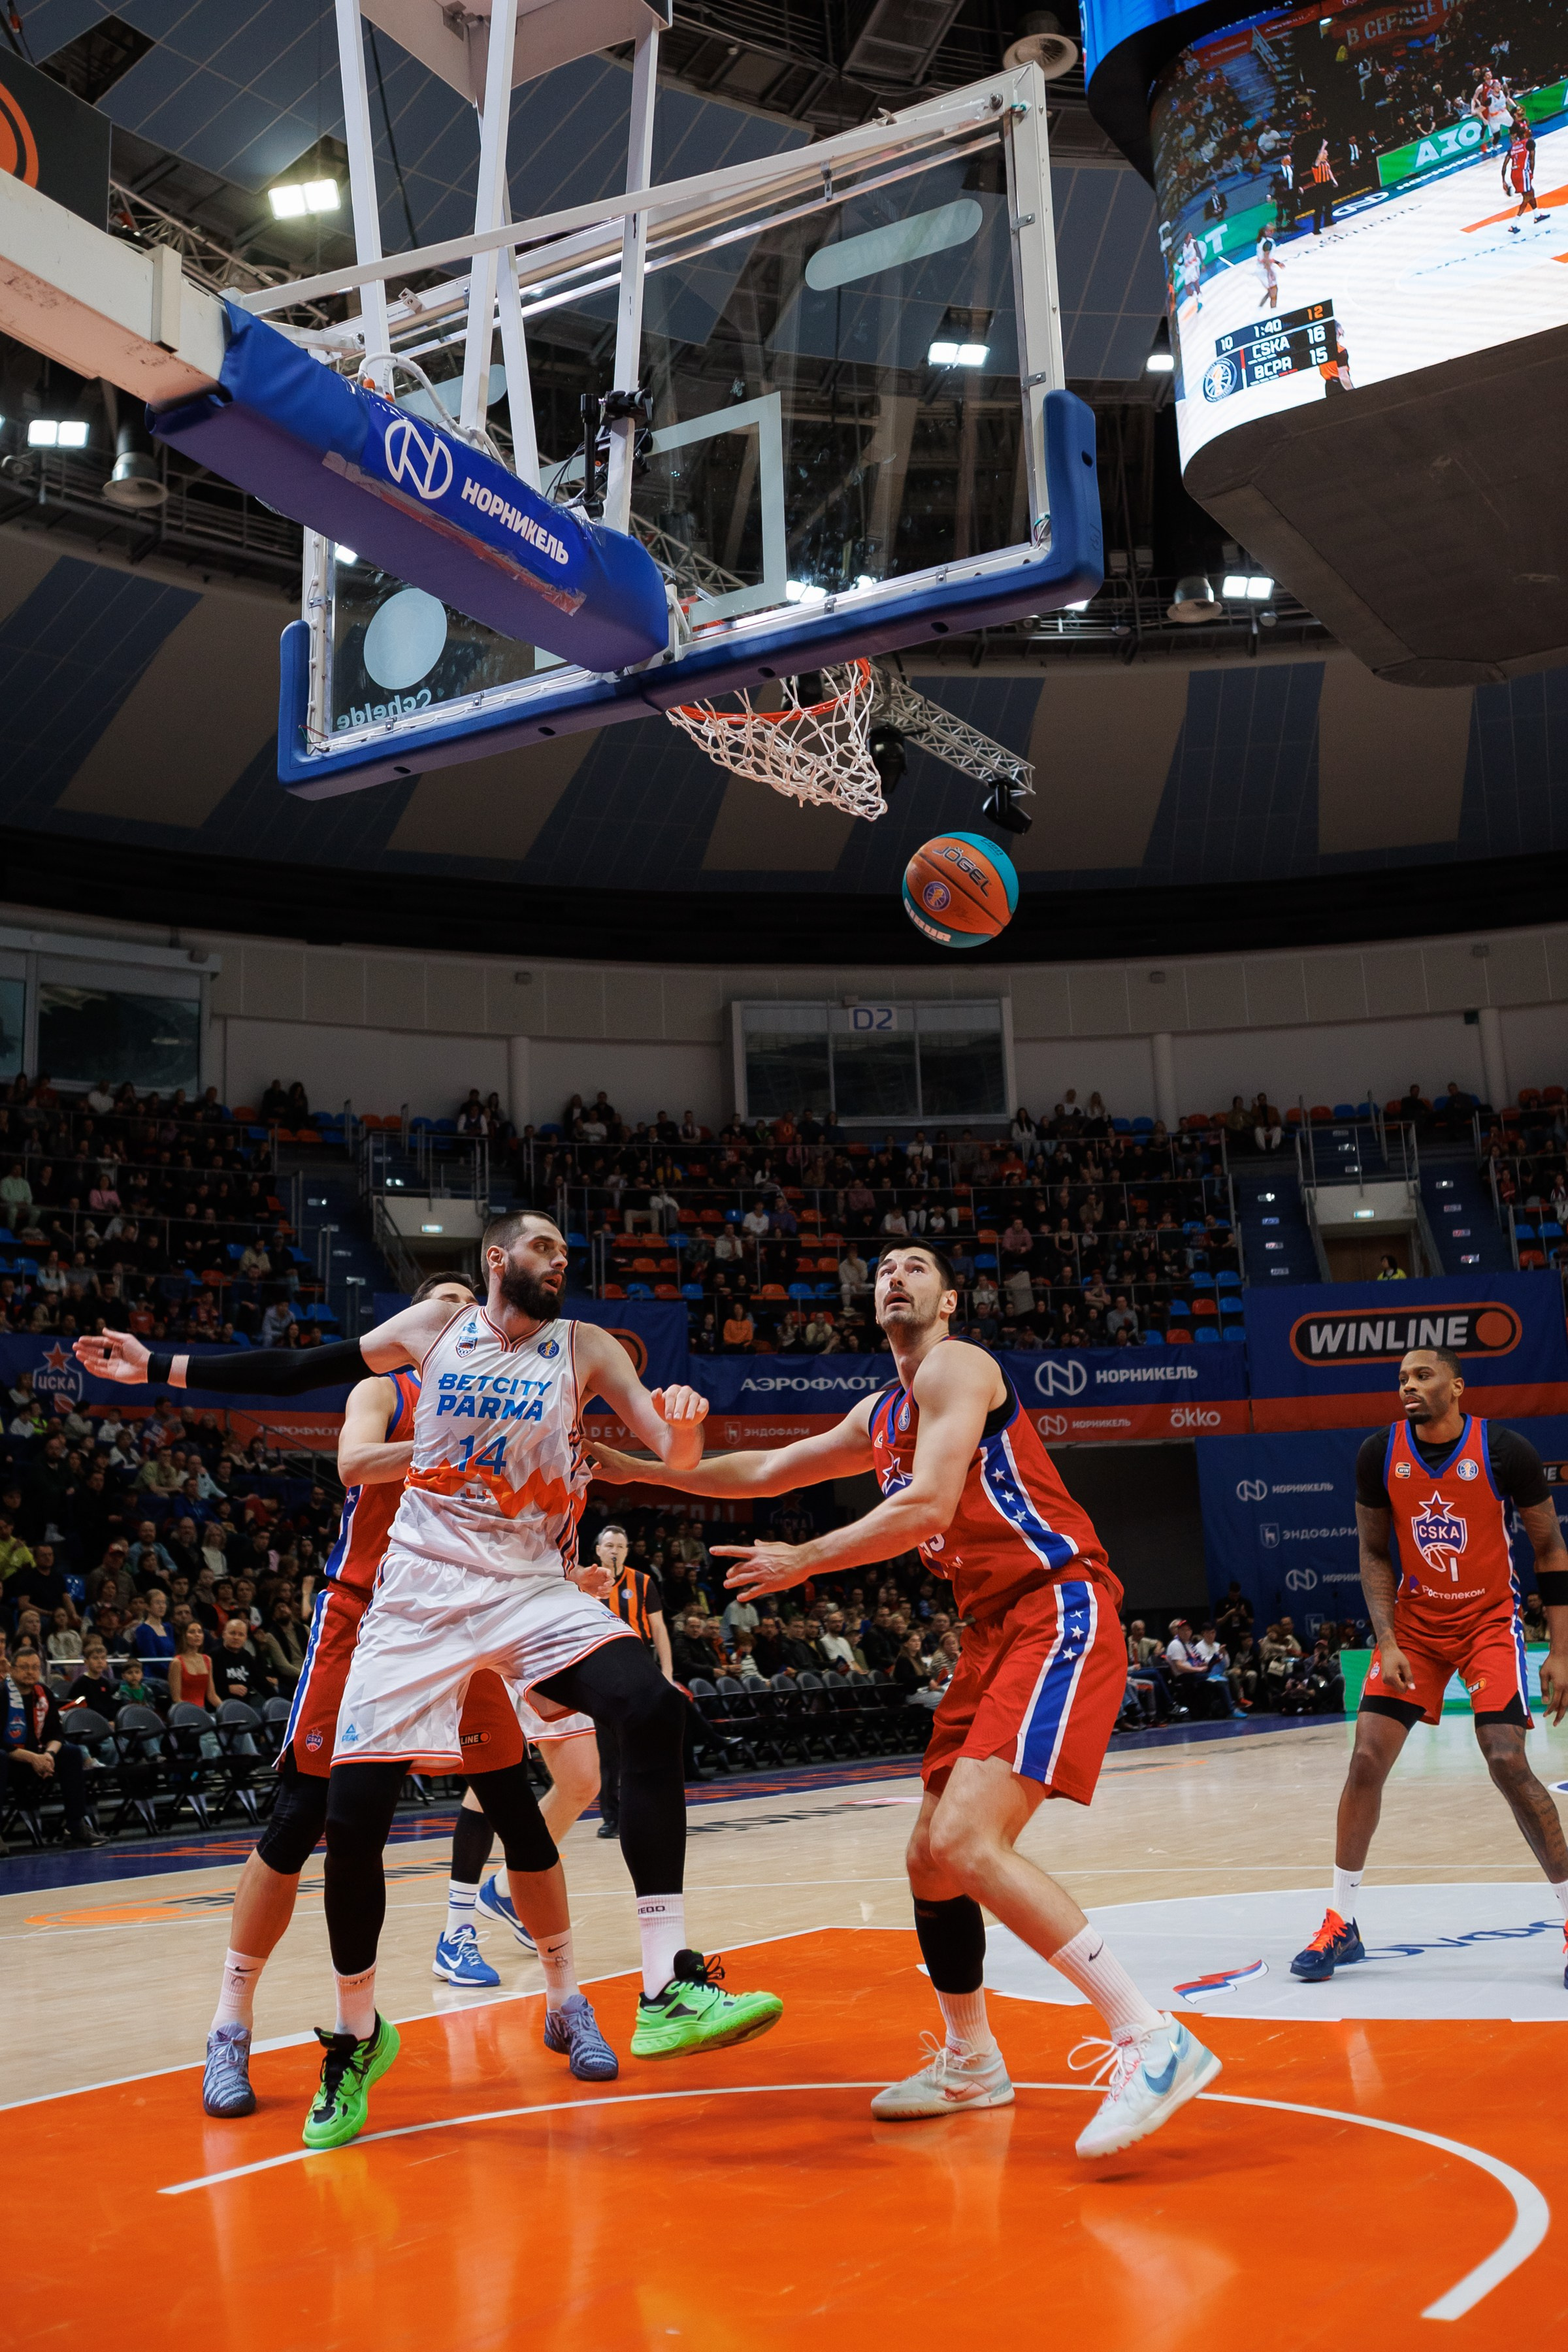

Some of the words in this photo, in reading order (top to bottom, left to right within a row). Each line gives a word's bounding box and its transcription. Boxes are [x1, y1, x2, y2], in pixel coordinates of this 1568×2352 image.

[1415, 120, 1493, 168] АЗО
[1254, 319, 1282, 337] 1:40
[1307, 305, 1324, 320] 12
[1252, 336, 1290, 359] CSKA
[1307, 325, 1326, 344] 16
[1254, 356, 1292, 379] BCPR
[1309, 346, 1328, 365] 15
[461, 477, 569, 565] НОРНИКЕЛЬ
[932, 846, 989, 898] JÖGEL
[853, 1008, 892, 1030] D2
[1309, 1316, 1469, 1354] WINLINE
[38, 1375, 76, 1390] ЦСКА
[438, 1373, 553, 1396] BETCITY
[740, 1377, 880, 1392] АЭРОФЛОТ
[1096, 1366, 1198, 1384] НОРНИКЕЛЬ
[436, 1395, 544, 1421] PARMA
[744, 1428, 810, 1437] ЭНДОФАРМ
[458, 1435, 507, 1475] 14
[1418, 1525, 1460, 1539] CSKA
[1450, 1557, 1459, 1582] 1
[1422, 1585, 1485, 1600] Ростелеком
